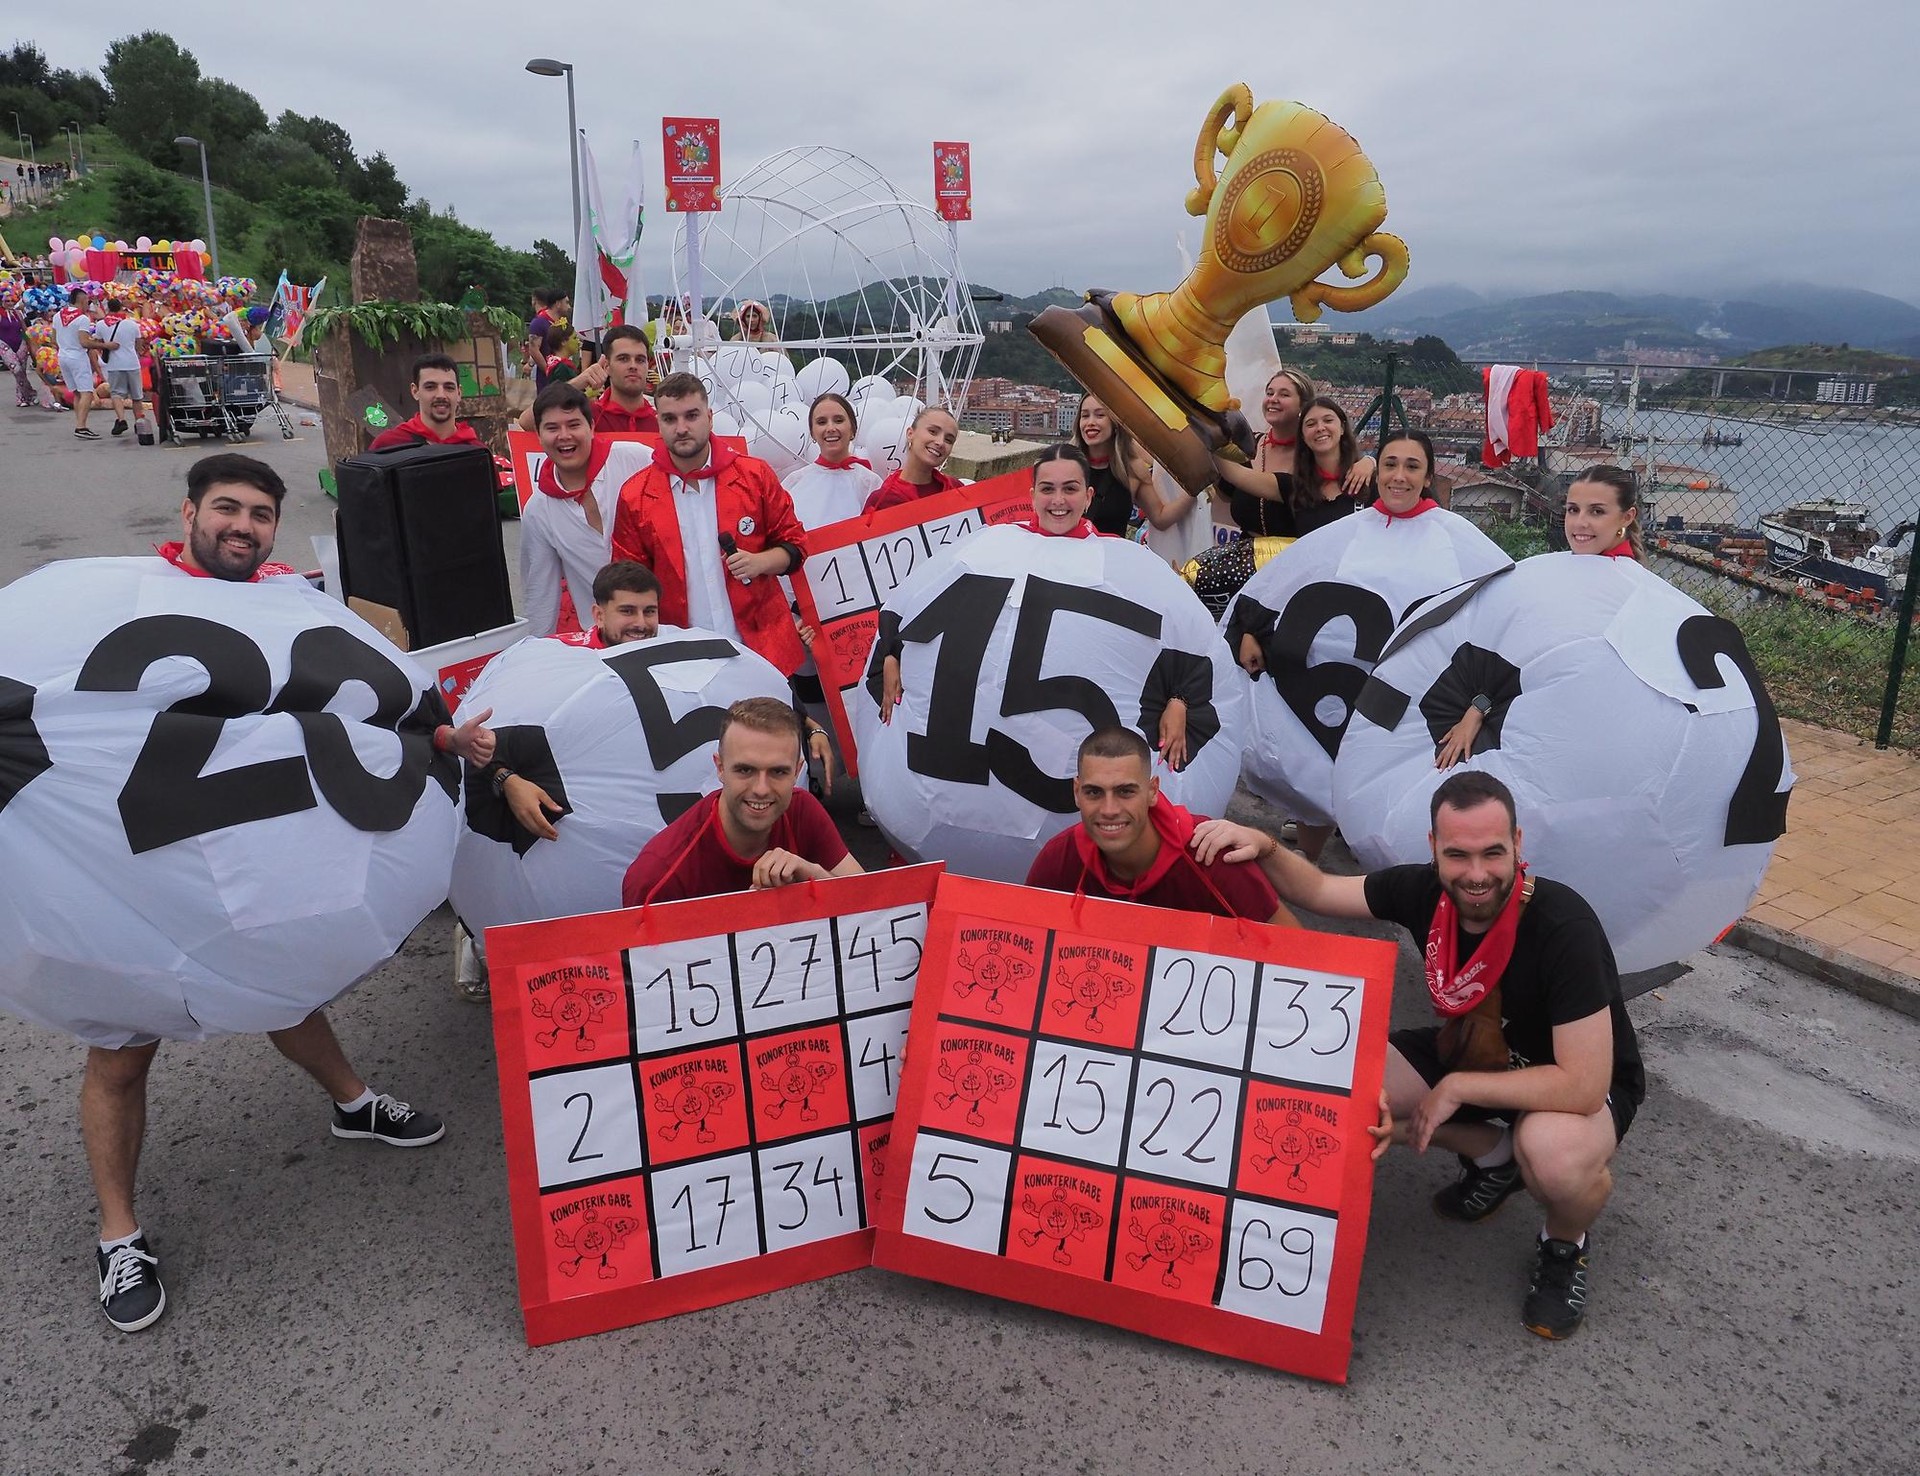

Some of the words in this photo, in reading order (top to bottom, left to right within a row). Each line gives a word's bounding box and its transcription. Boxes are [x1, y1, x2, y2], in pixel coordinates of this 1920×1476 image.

[821, 557, 855, 606] 1
[901, 573, 1162, 814] 15
[74, 614, 430, 855] 28
[601, 638, 741, 826] 5
[751, 934, 821, 1009] 27
[848, 912, 922, 993] 45
[960, 928, 1012, 943] KONORTERIK
[1012, 937, 1034, 954] GABE
[1058, 945, 1113, 962] KONORTERIK
[1113, 954, 1134, 971] GABE
[526, 966, 584, 995] KONORTERIK
[585, 965, 610, 981] GABE
[646, 959, 720, 1034] 15
[1160, 956, 1237, 1037] 20
[939, 1038, 993, 1054] KONORTERIK
[993, 1047, 1015, 1065] GABE
[1269, 978, 1356, 1055] 33
[648, 1060, 704, 1089] KONORTERIK
[704, 1057, 729, 1074] GABE
[756, 1041, 807, 1068] KONORTERIK
[807, 1039, 831, 1054] GABE
[858, 1030, 909, 1096] 4
[564, 1093, 604, 1164] 2
[1043, 1054, 1117, 1135] 15
[1139, 1078, 1222, 1164] 22
[1256, 1097, 1313, 1115] KONORTERIK
[1314, 1108, 1338, 1127] GABE
[550, 1195, 608, 1224] KONORTERIK
[608, 1193, 633, 1209] GABE
[672, 1176, 736, 1253] 17
[773, 1156, 844, 1231] 34
[924, 1154, 979, 1224] 5
[1023, 1173, 1078, 1189] KONORTERIK
[1079, 1184, 1102, 1202] GABE
[1130, 1195, 1187, 1213] KONORTERIK
[1187, 1205, 1211, 1225] GABE
[1239, 1220, 1314, 1296] 69
